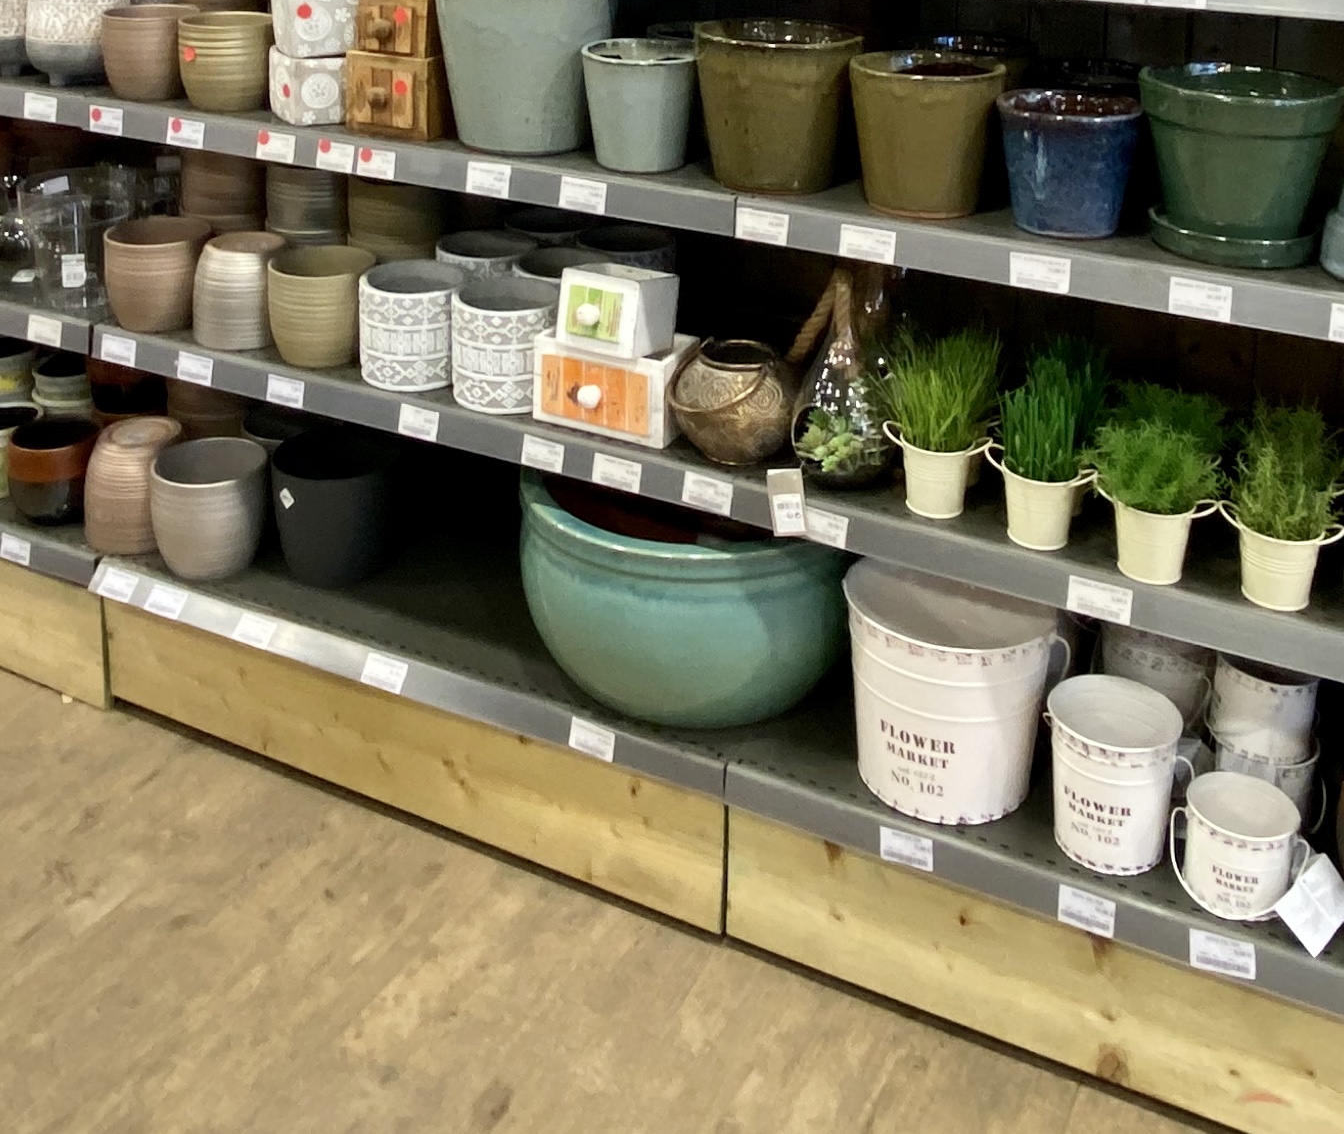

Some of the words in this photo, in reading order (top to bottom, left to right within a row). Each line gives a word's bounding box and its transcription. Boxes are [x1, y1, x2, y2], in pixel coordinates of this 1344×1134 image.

[880, 718, 956, 754] FLOWER
[887, 740, 949, 769] MARKET
[891, 769, 914, 791] No.
[919, 781, 944, 797] 102
[1063, 785, 1132, 816] FLOWER
[1068, 801, 1126, 827] MARKET
[1097, 833, 1120, 846] 102
[1212, 864, 1259, 884] FLOWER
[1216, 876, 1254, 893] MARKET
